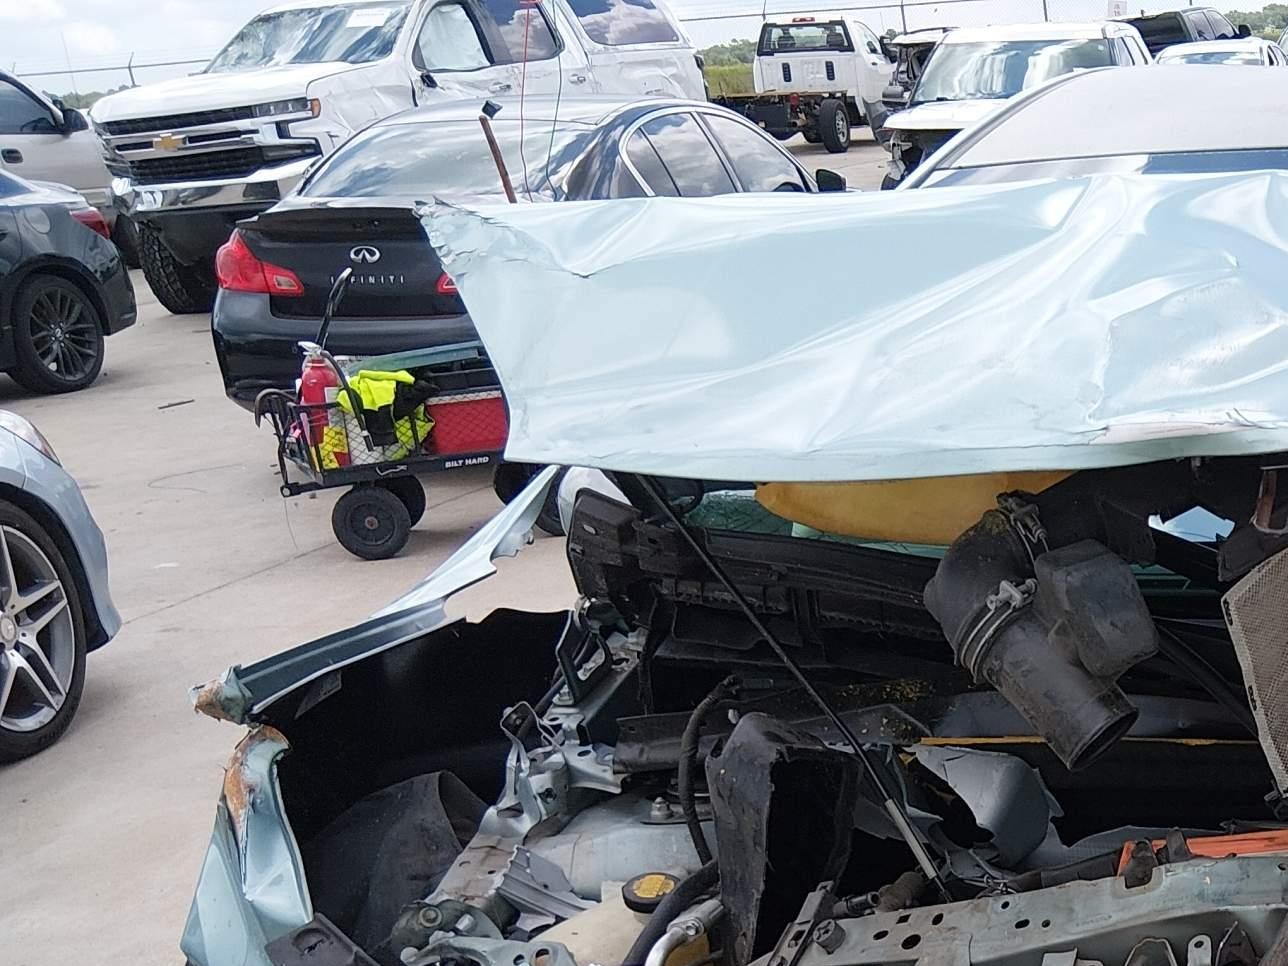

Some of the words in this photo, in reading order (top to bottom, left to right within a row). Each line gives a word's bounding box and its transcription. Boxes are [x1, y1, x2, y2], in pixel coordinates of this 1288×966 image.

[330, 275, 404, 284] IFINITI
[445, 460, 464, 469] BILT
[465, 456, 490, 466] HARD
